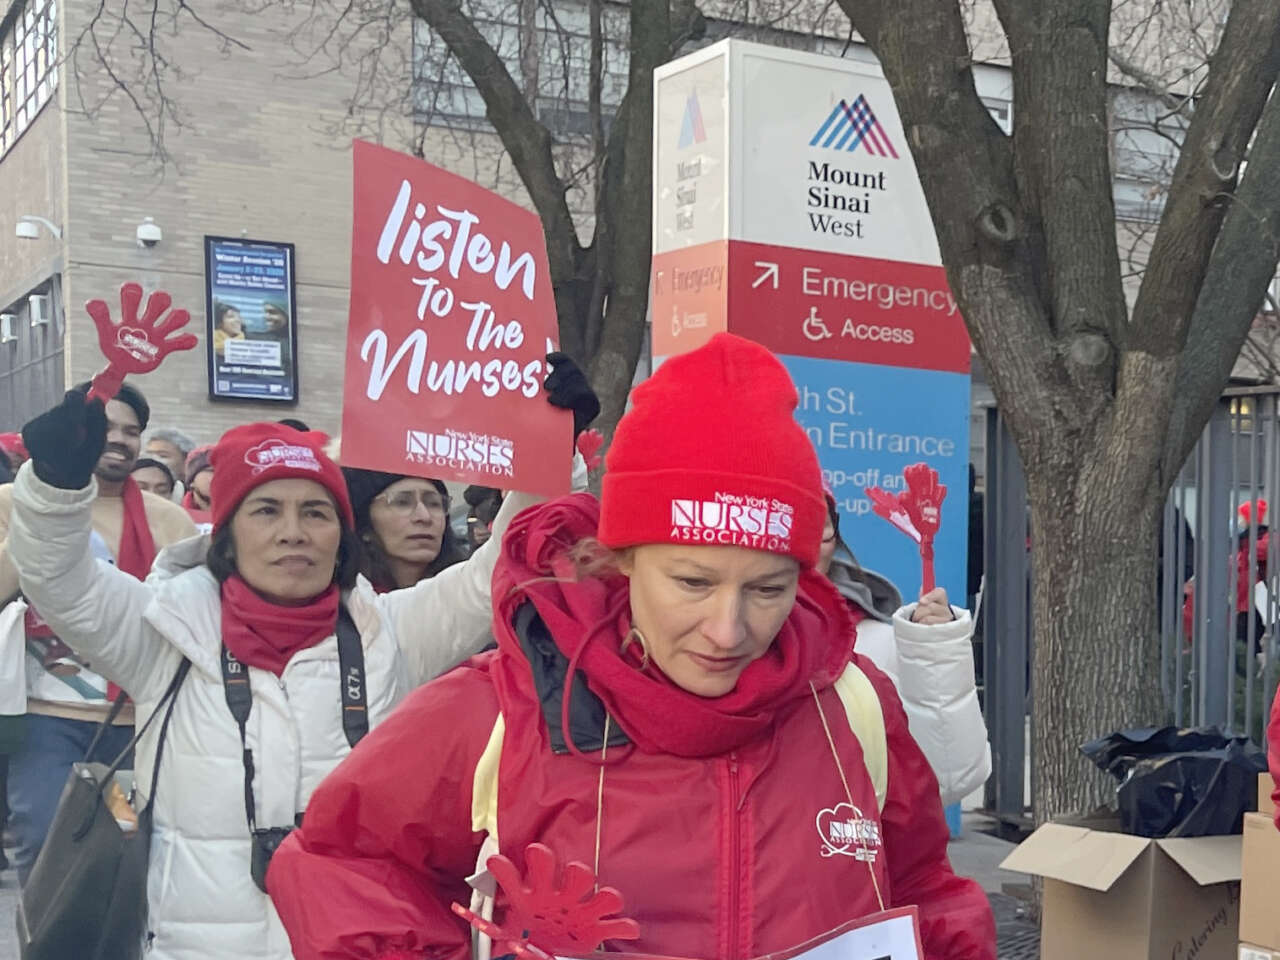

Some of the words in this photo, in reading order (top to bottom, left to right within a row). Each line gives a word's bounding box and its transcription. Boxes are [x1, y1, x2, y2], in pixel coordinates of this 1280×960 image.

[808, 161, 887, 191] Mount
[807, 187, 871, 214] Sinai
[808, 212, 864, 239] West
[672, 265, 725, 294] Emergency
[802, 267, 957, 317] Emergency
[412, 277, 454, 321] To
[460, 301, 524, 351] The
[841, 319, 914, 344] Access
[826, 387, 863, 416] St.
[406, 430, 514, 468] NURSES
[829, 422, 955, 457] Entrance
[405, 451, 513, 477] ASSOCIATION
[715, 491, 742, 505] New
[744, 495, 768, 510] York
[770, 499, 794, 515] State
[671, 499, 793, 539] NURSES
[670, 526, 790, 552] ASSOCIATION
